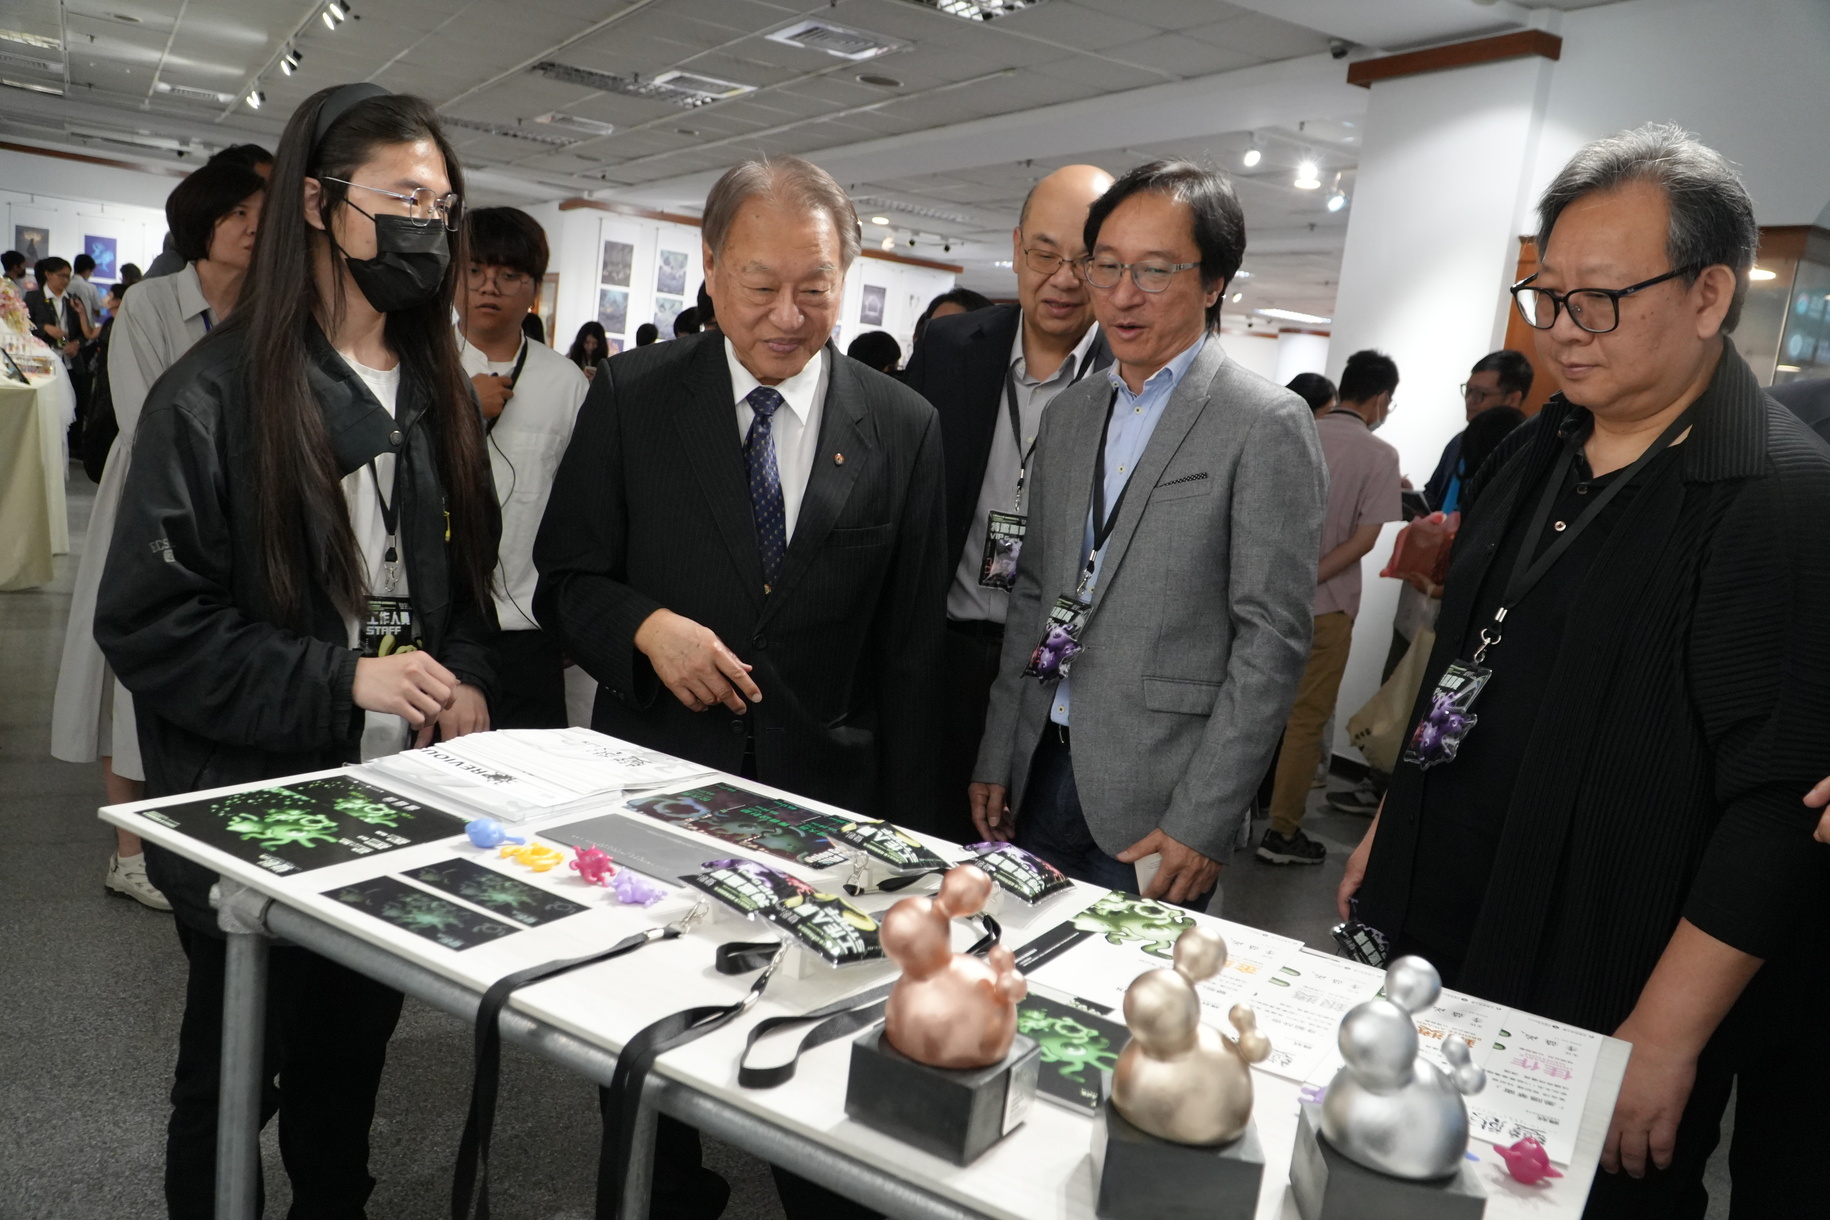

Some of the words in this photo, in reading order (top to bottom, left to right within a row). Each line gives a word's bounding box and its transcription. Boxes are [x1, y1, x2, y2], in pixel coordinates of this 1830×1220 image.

[990, 532, 1004, 540] VIP
[366, 611, 411, 625] 工作人員
[366, 626, 401, 635] STAFF
[856, 827, 910, 862] 工作人員
[793, 905, 857, 954] 工作人員
[824, 907, 864, 953] STAFF
[1509, 1056, 1573, 1081] 佳作
